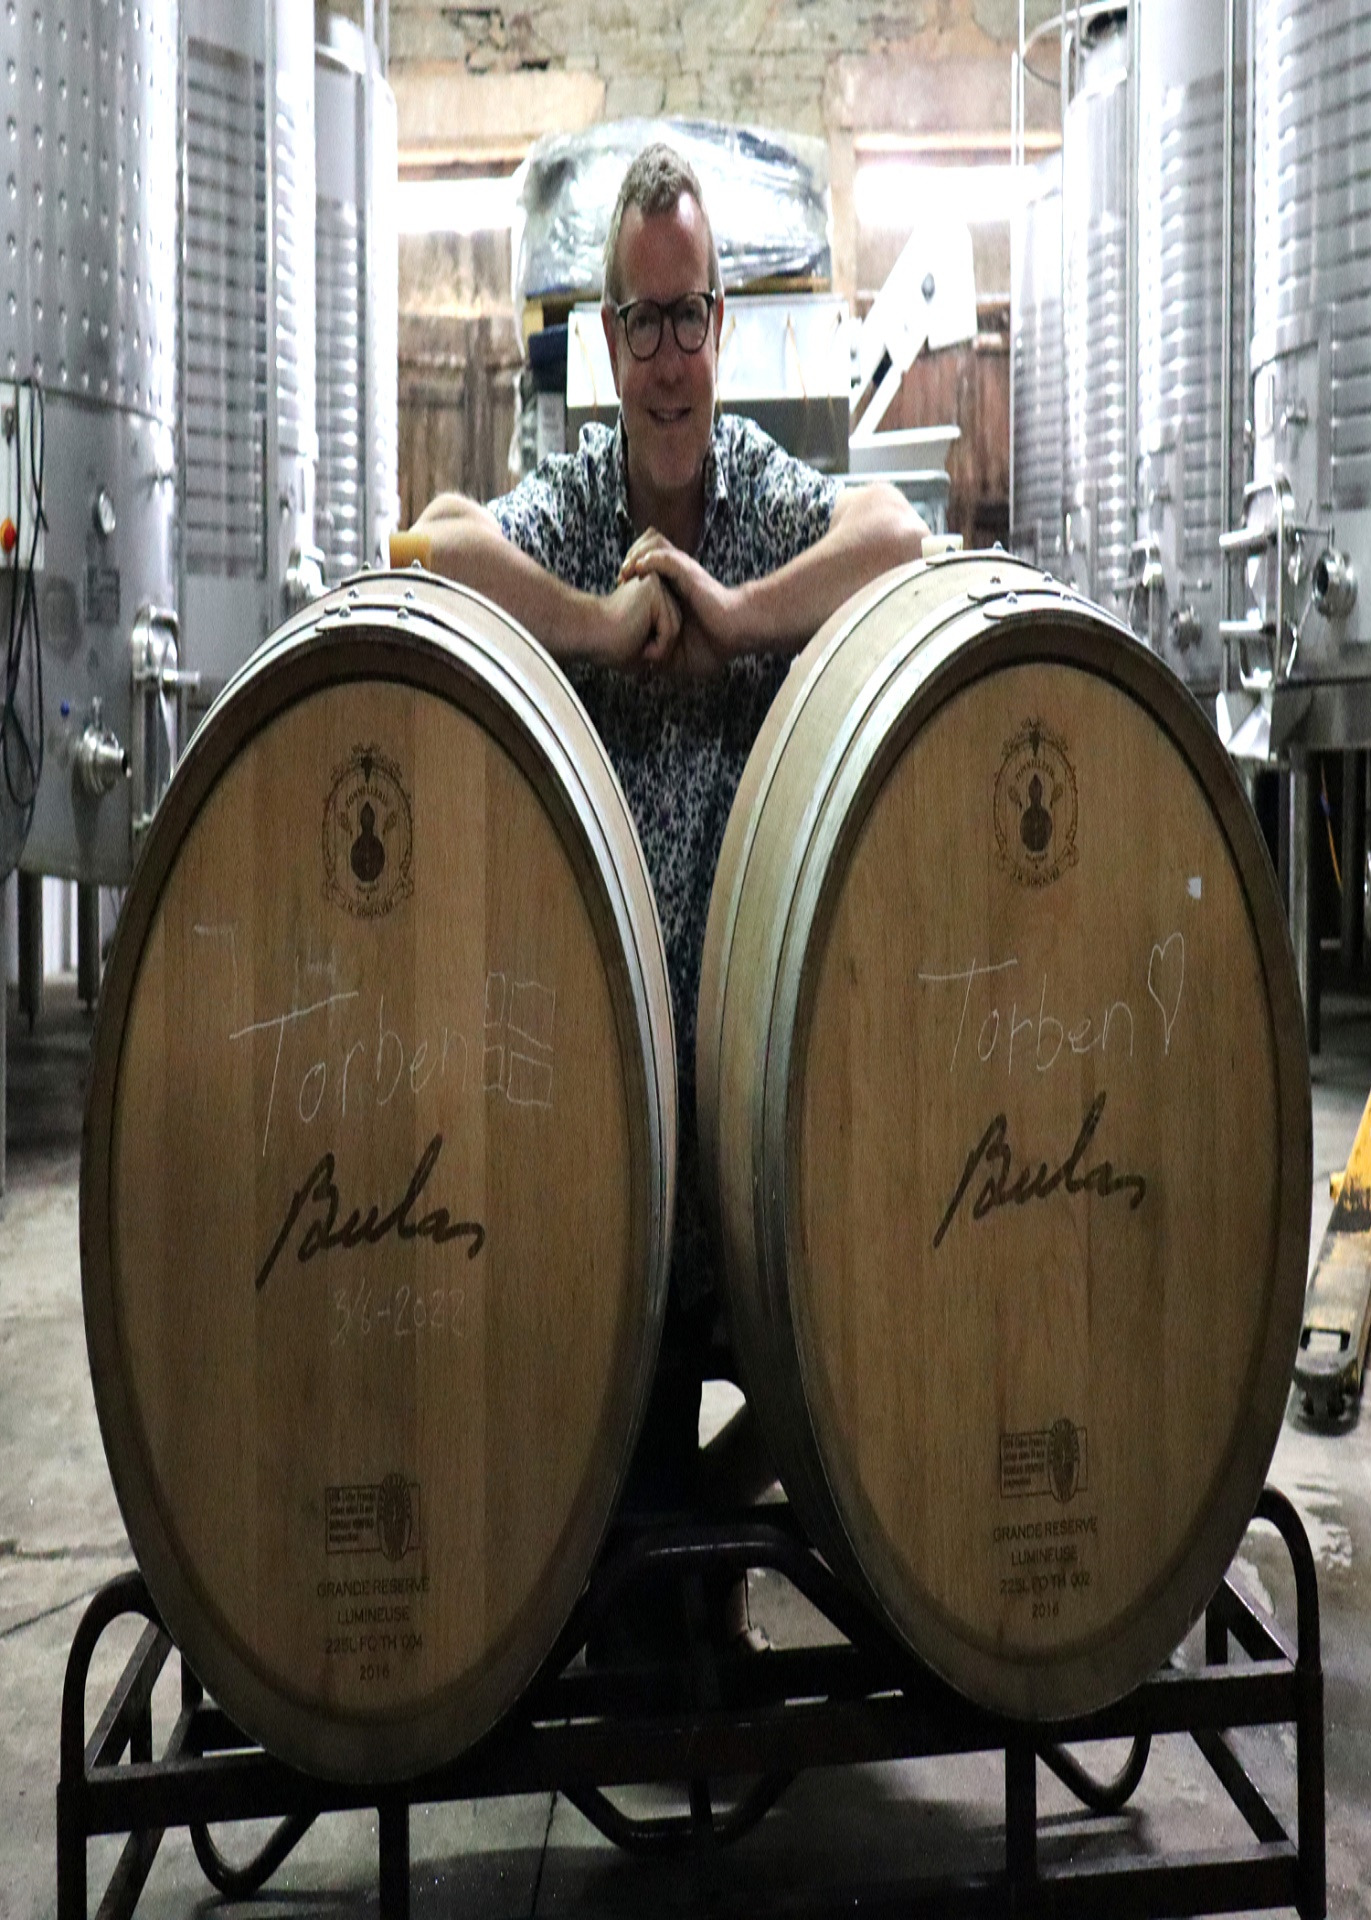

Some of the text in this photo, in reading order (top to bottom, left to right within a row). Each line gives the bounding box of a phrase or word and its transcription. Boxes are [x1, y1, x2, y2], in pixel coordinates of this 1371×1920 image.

[918, 957, 1134, 1076] Torben
[228, 990, 470, 1157] Torben
[993, 1516, 1098, 1542] GRANDE RESERVE
[1011, 1545, 1079, 1566] LUMINEUSE
[317, 1575, 430, 1597] GRANDE RESERVE
[337, 1605, 410, 1625] LUMINEUSE
[360, 1663, 390, 1681] 2016
